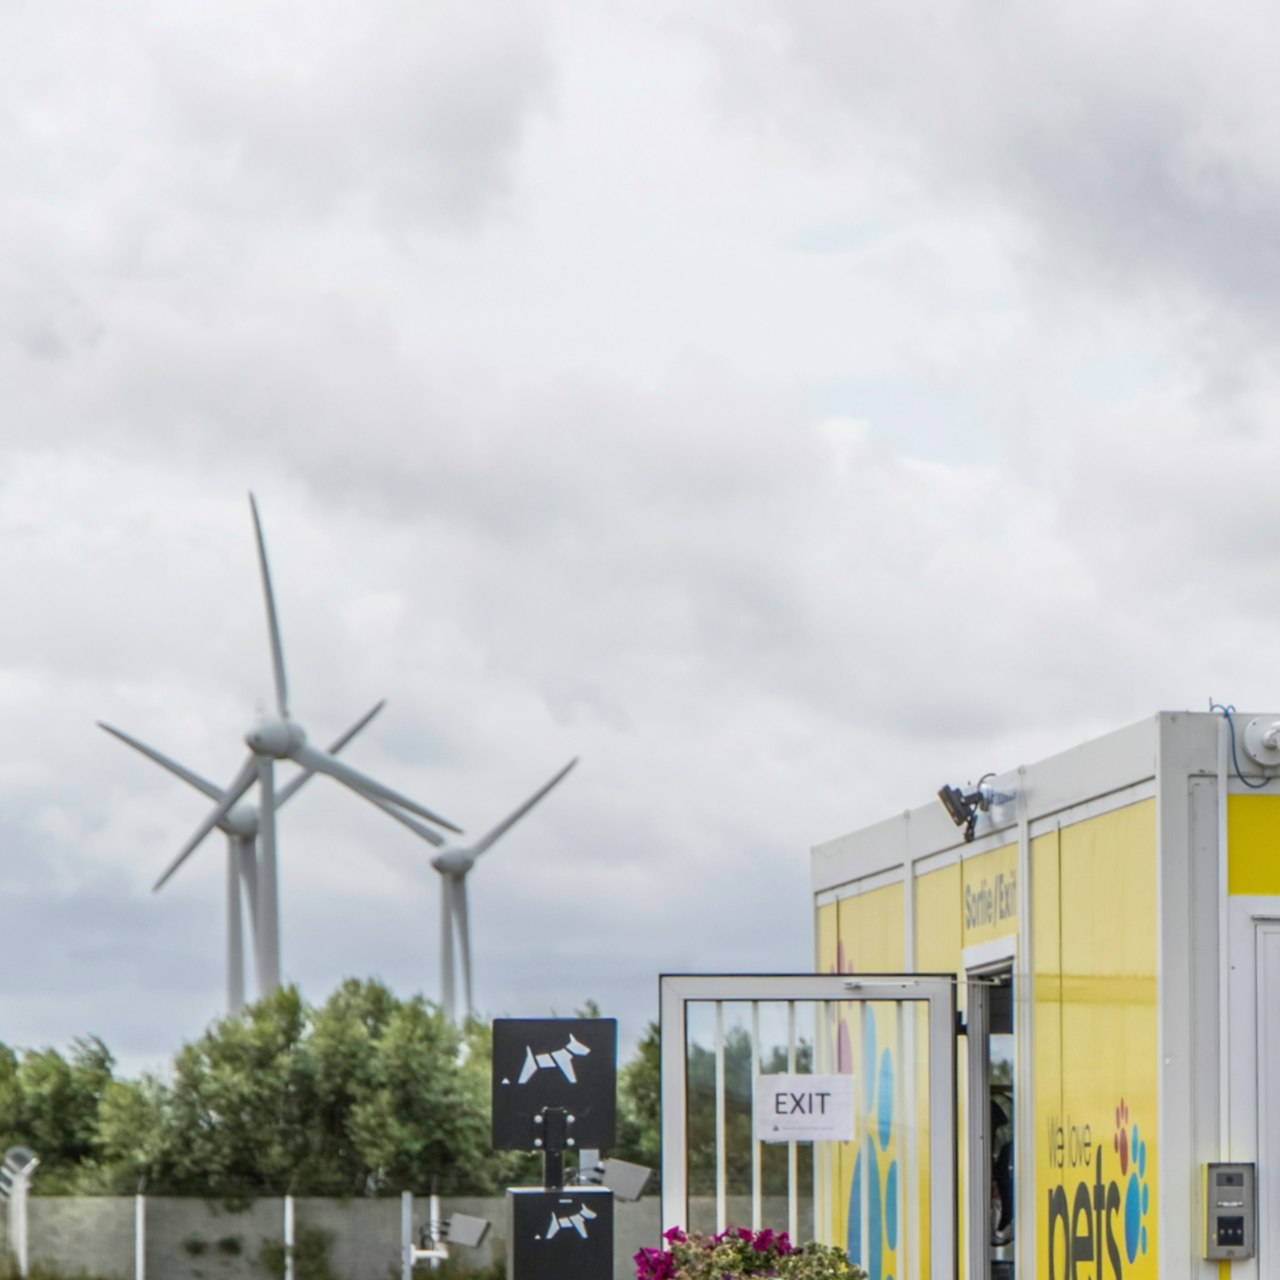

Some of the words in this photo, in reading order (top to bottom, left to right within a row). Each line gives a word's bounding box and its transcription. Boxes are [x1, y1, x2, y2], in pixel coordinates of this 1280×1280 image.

[774, 1092, 831, 1115] EXIT
[1046, 1115, 1065, 1169] We
[1067, 1113, 1092, 1169] love
